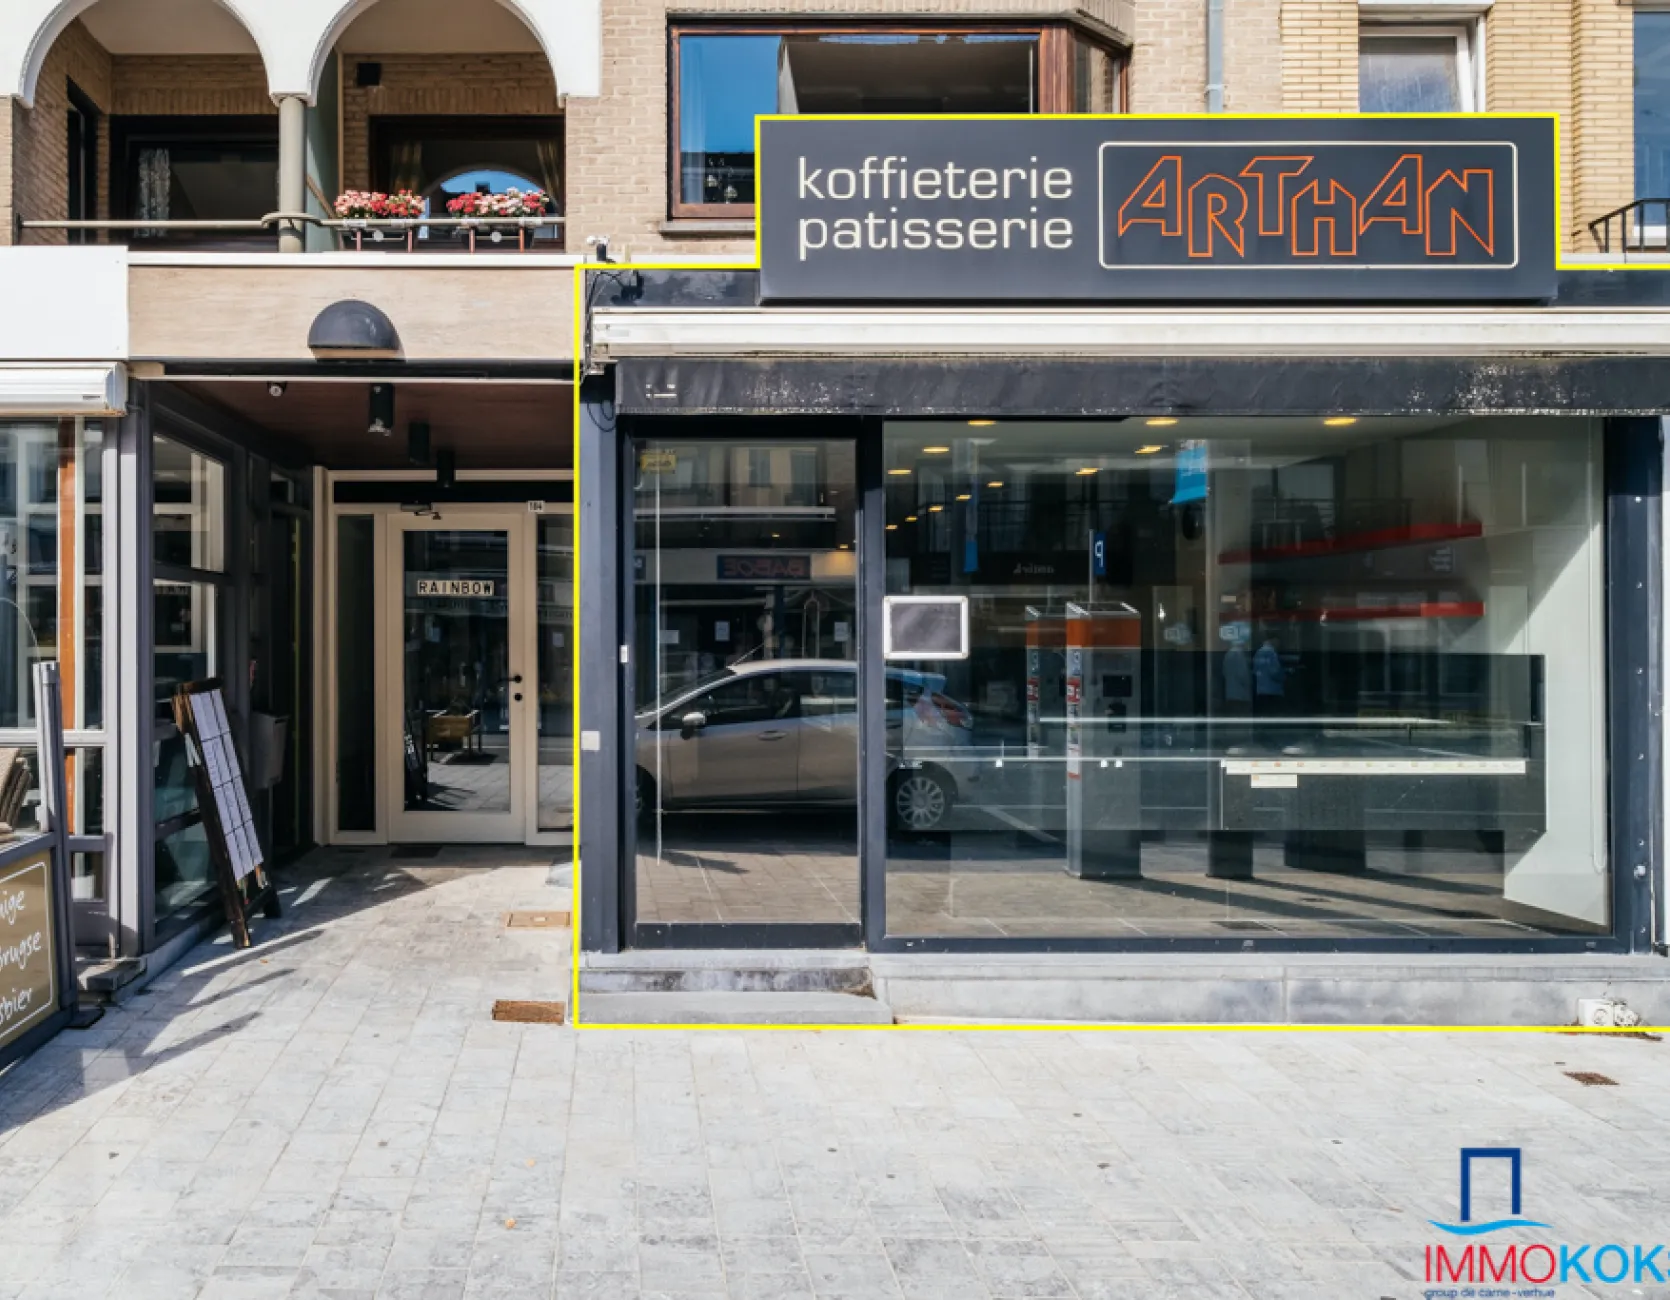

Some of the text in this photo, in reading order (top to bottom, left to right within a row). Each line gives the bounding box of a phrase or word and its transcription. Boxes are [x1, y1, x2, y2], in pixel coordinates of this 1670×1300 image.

[799, 155, 1073, 200] koffieterie
[799, 207, 1073, 262] patisserie
[418, 581, 492, 595] RAINBOW
